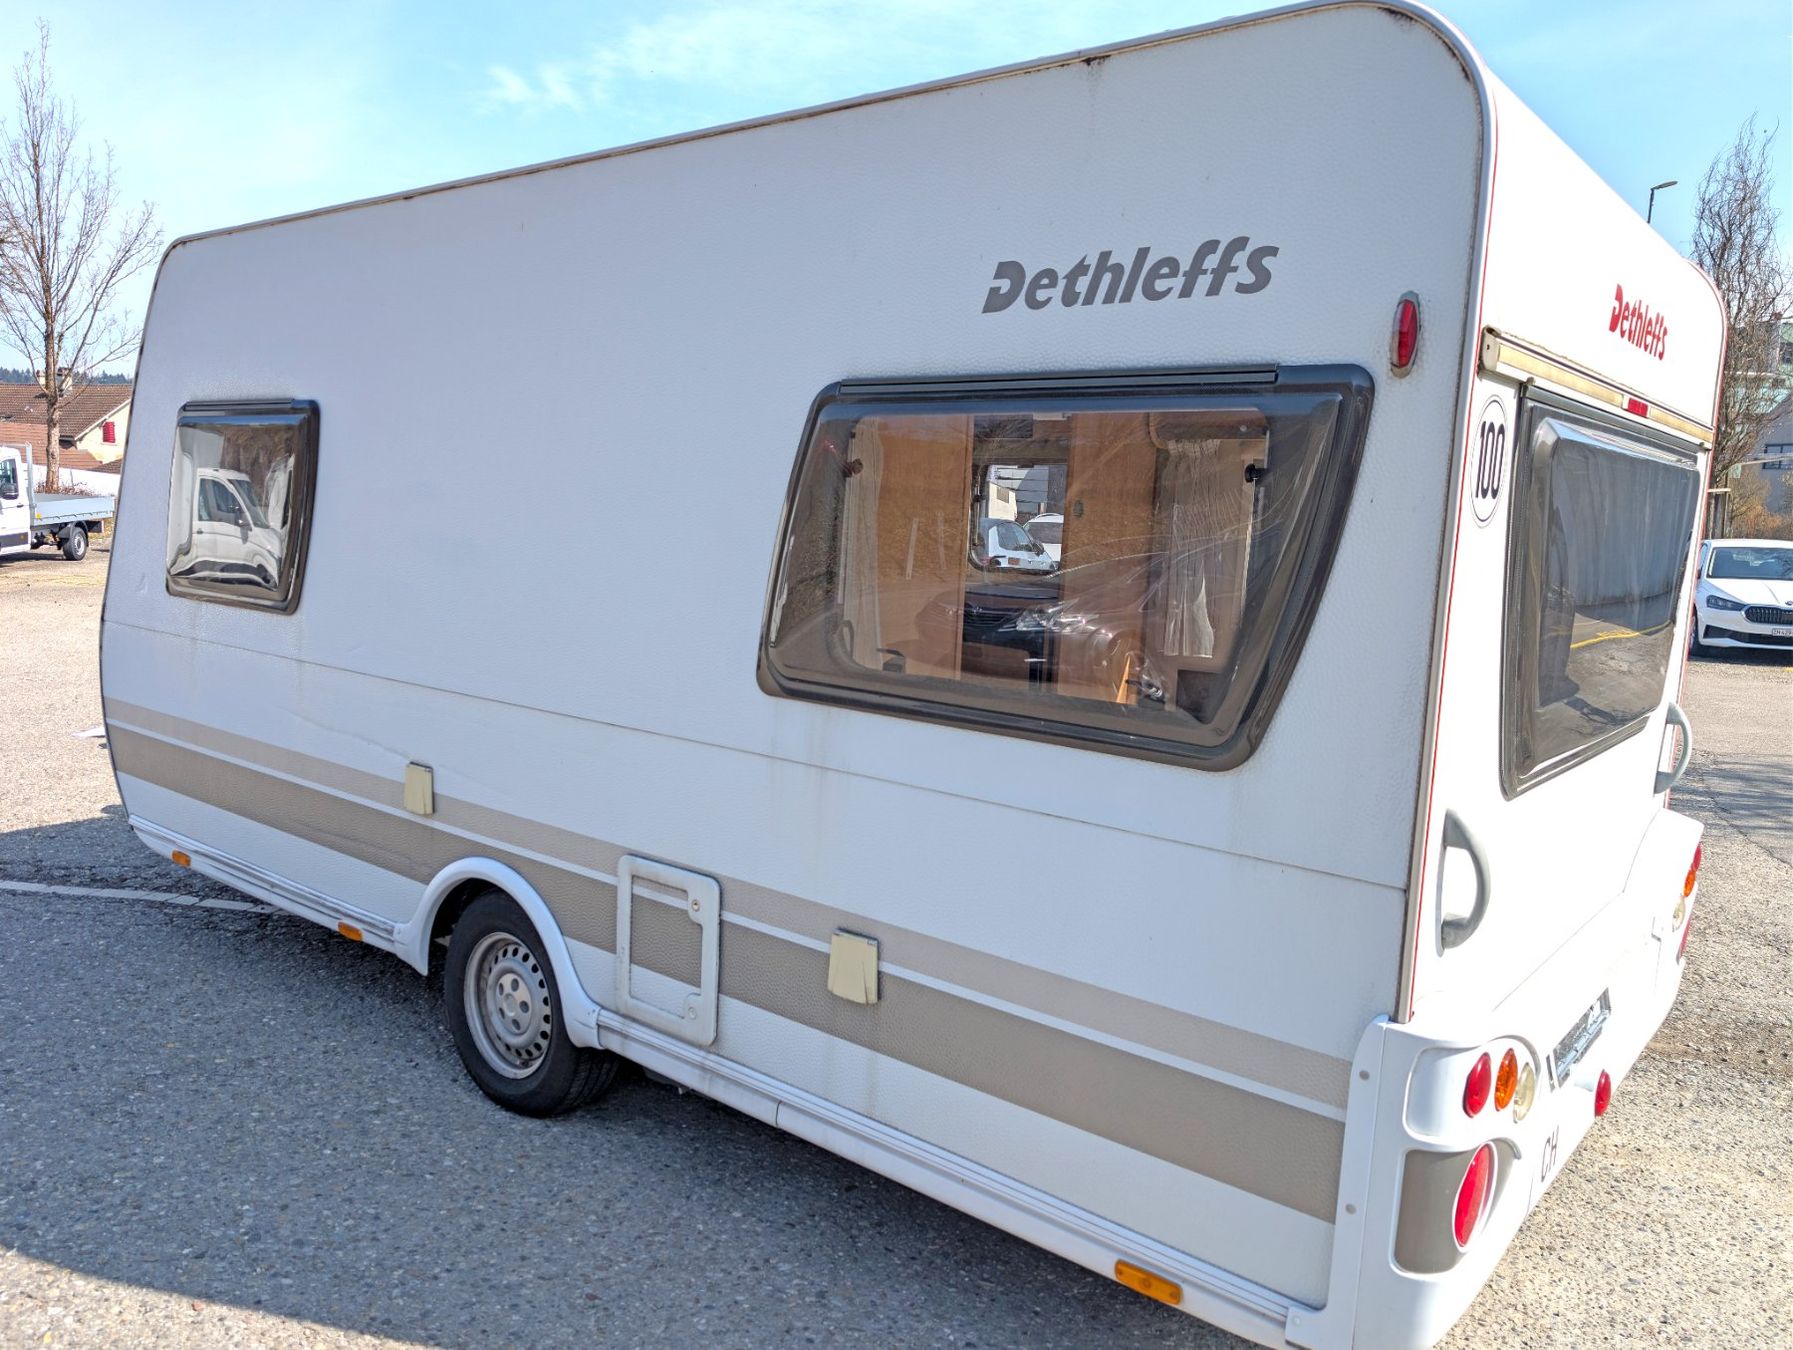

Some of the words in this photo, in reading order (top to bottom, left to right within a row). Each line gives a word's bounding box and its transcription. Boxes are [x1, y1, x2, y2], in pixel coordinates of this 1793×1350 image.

[982, 236, 1280, 314] Dethleffs
[1609, 283, 1668, 360] Dethleffs
[1475, 420, 1506, 500] 100
[1541, 1124, 1560, 1183] CH
